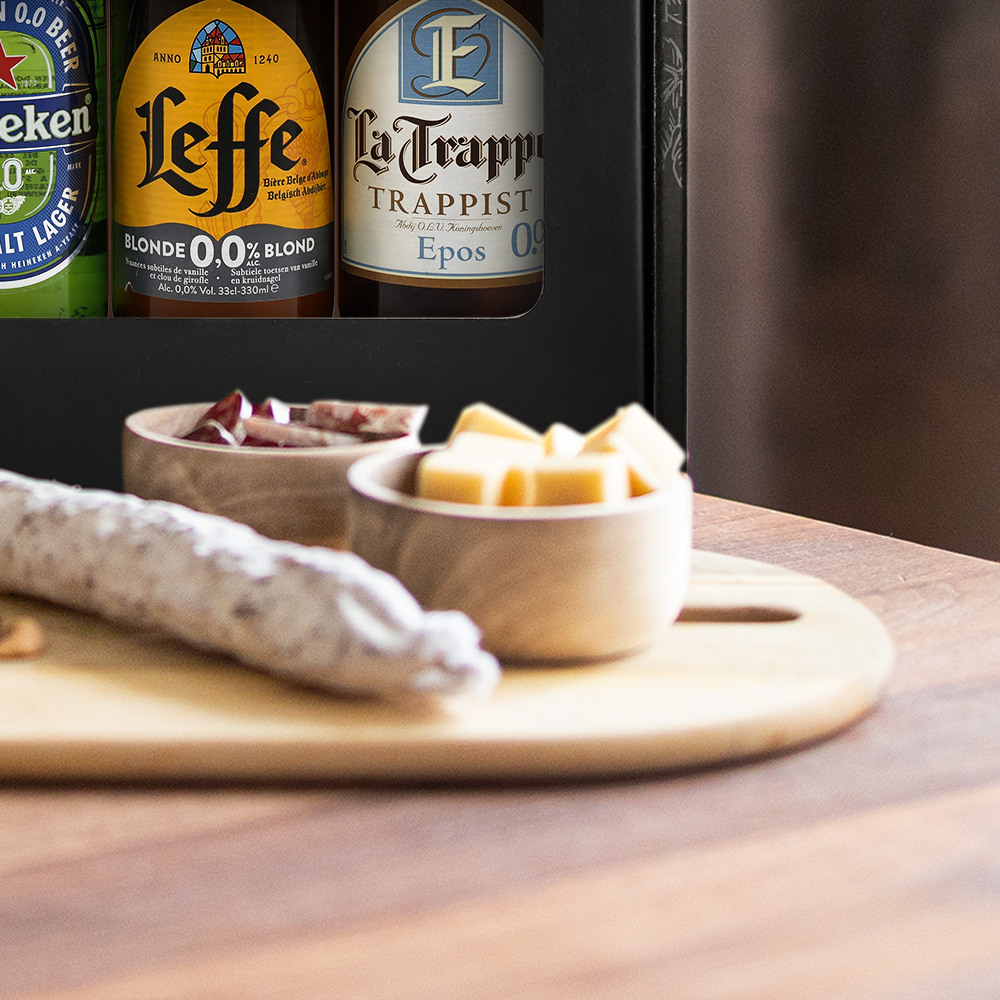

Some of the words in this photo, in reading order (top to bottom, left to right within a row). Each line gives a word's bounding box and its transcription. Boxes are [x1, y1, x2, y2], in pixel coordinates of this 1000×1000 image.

[14, 2, 47, 28] 0.0
[45, 16, 80, 74] BEER
[153, 52, 182, 64] ANNO
[253, 53, 280, 65] 1240
[134, 81, 304, 218] Leffe
[346, 106, 396, 183] La
[262, 177, 286, 188] Bière
[286, 174, 307, 186] Belge
[267, 187, 301, 202] Belgisch
[367, 185, 533, 217] TRAPPIST
[32, 186, 80, 246] LAGER
[11, 250, 53, 269] HEINEKEN
[55, 223, 80, 253] A-YEAST
[124, 232, 186, 259] BLONDE
[264, 236, 315, 259] BLOND
[417, 235, 486, 271] Epos
[125, 256, 147, 270] Nuances
[147, 263, 172, 274] subtiles
[173, 266, 183, 275] de
[183, 267, 209, 276] vanille
[230, 267, 262, 277] Subtiele
[263, 266, 289, 275] toetsen
[156, 272, 172, 282] clou
[173, 274, 182, 283] de
[183, 276, 209, 285] girofle
[230, 277, 240, 285] en
[242, 274, 281, 285] kruidnagel
[158, 282, 173, 293] Alc.
[174, 284, 198, 296] 0,0%
[199, 285, 216, 296] Vol.
[218, 284, 269, 296] 33cl-330ml
